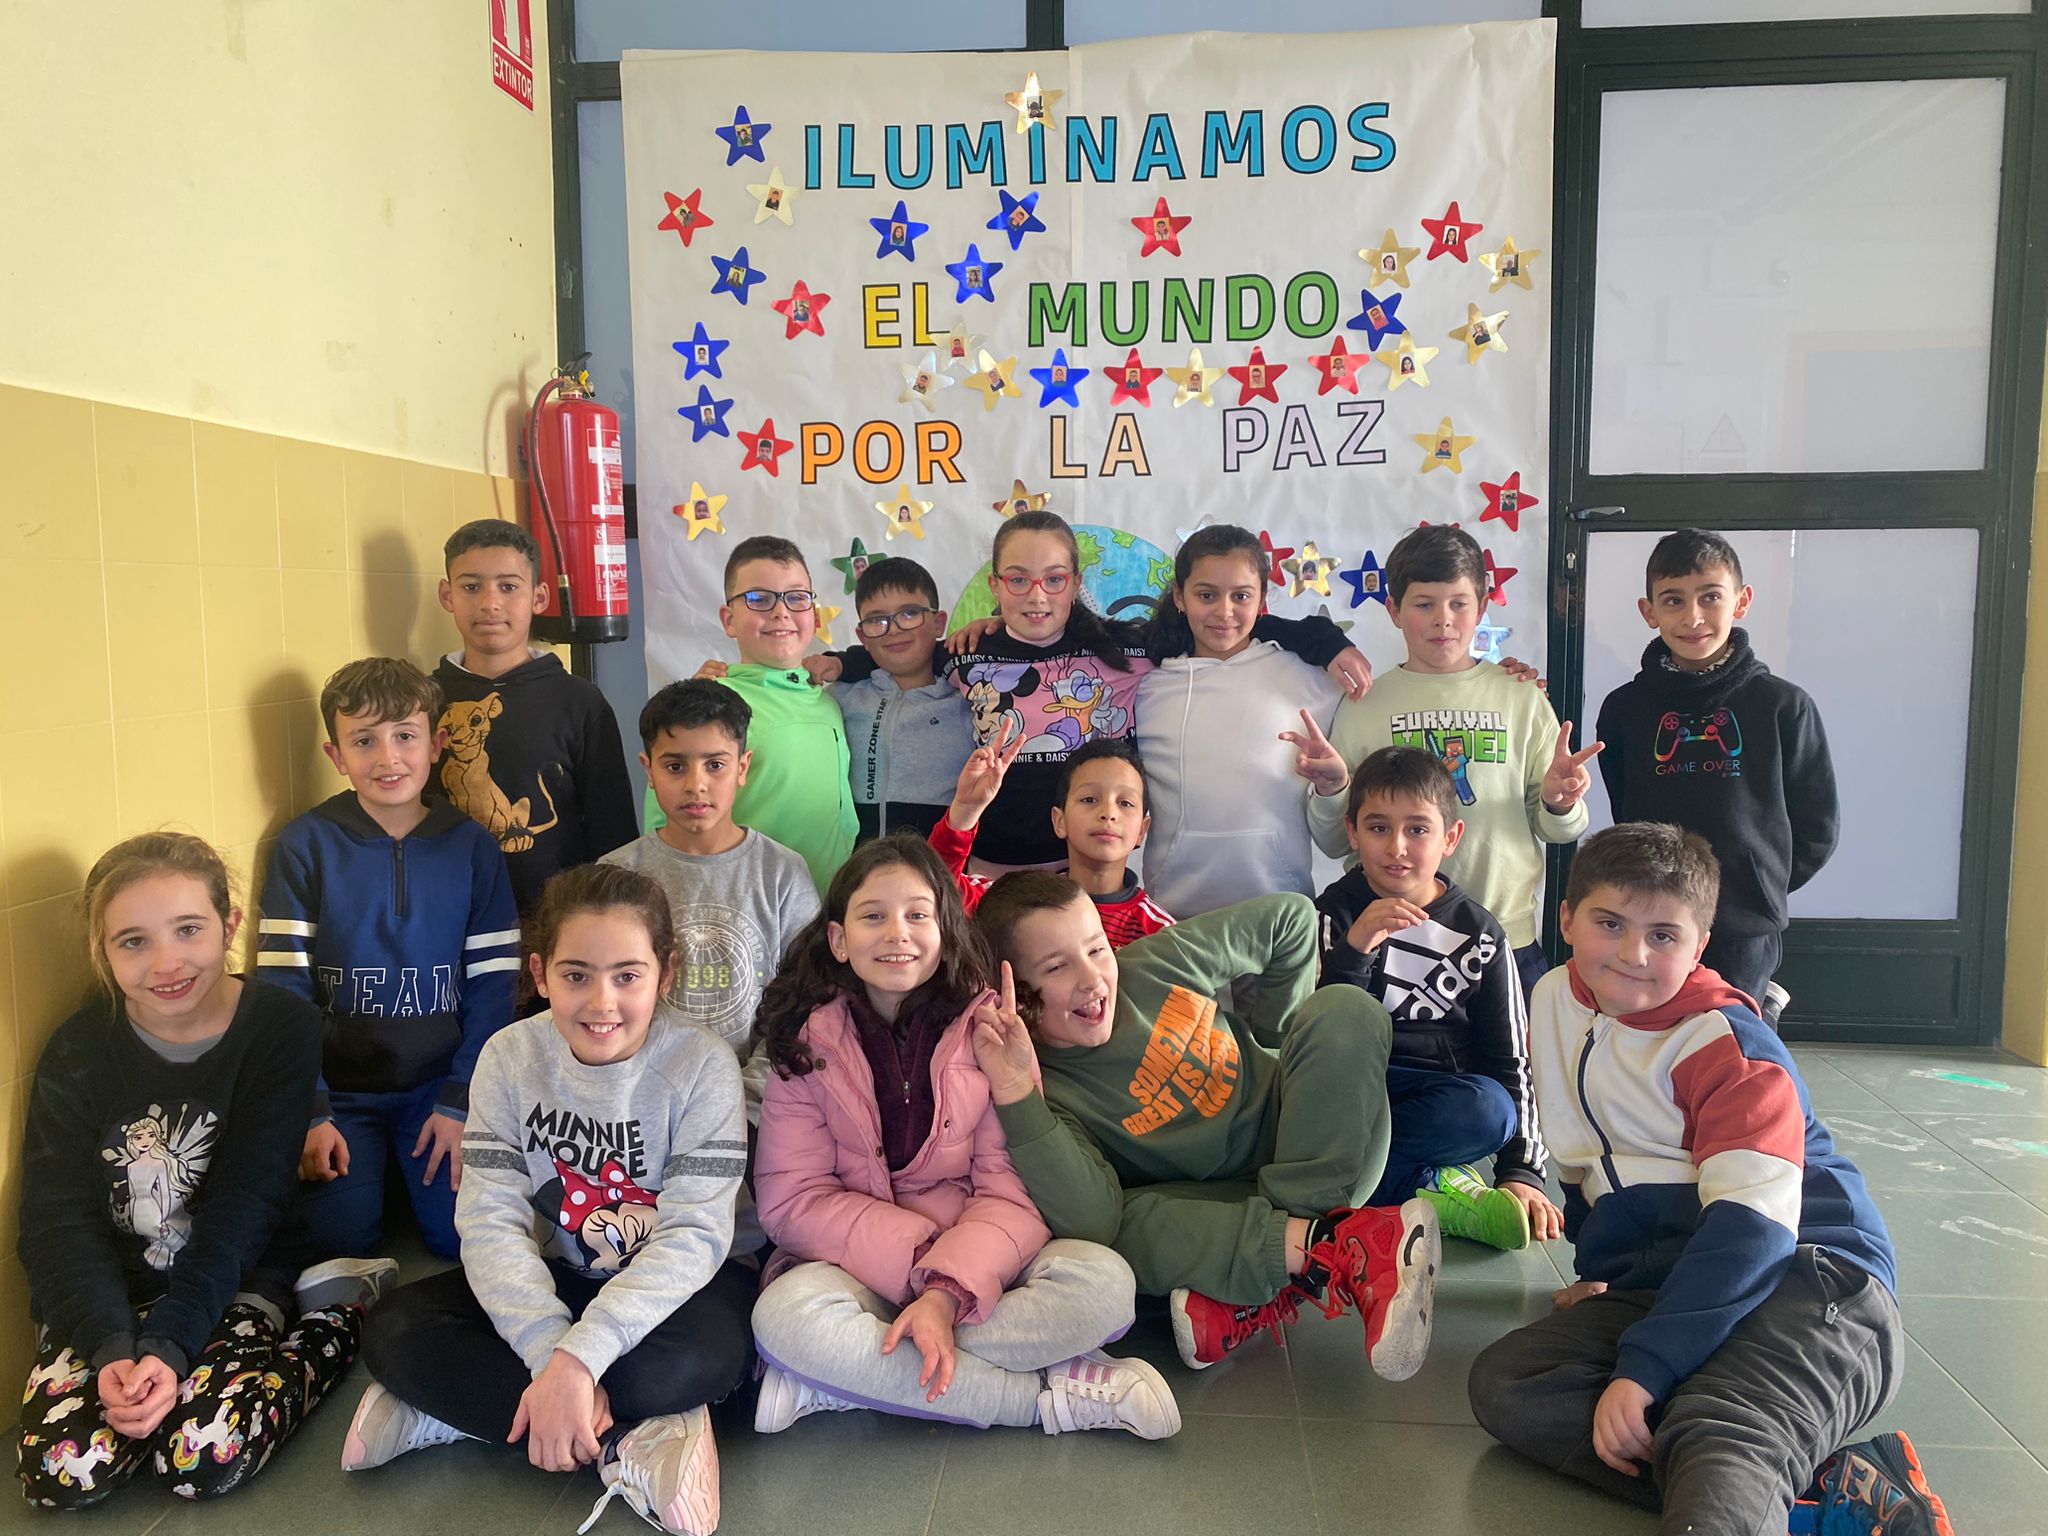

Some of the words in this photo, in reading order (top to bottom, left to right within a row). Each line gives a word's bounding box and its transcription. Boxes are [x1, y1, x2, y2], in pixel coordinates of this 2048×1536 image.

[493, 52, 533, 103] EXTINTOR
[803, 102, 1397, 190] ILUMINAMOS
[862, 281, 948, 350] EL
[1028, 270, 1340, 348] MUNDO
[800, 419, 967, 485] POR
[1049, 412, 1152, 479] LA
[1222, 399, 1387, 473] PAZ
[961, 654, 985, 665] DAISY
[1123, 647, 1146, 657] DAISY
[868, 721, 881, 755] ZONE
[1391, 709, 1507, 731] SURVIVAL
[866, 756, 876, 800] GAMER
[1035, 753, 1043, 763] &
[1045, 752, 1071, 763] DAISY
[1655, 761, 1697, 775] GAME
[1703, 759, 1741, 772] OVER
[735, 916, 765, 963] WORLD
[317, 959, 462, 1018] TEAM
[1395, 933, 1497, 1020] didas
[1121, 1086, 1184, 1137] GREAT
[1170, 1061, 1206, 1099] IS
[525, 1101, 645, 1151] MINNIE
[526, 1129, 648, 1179] MOUSE
